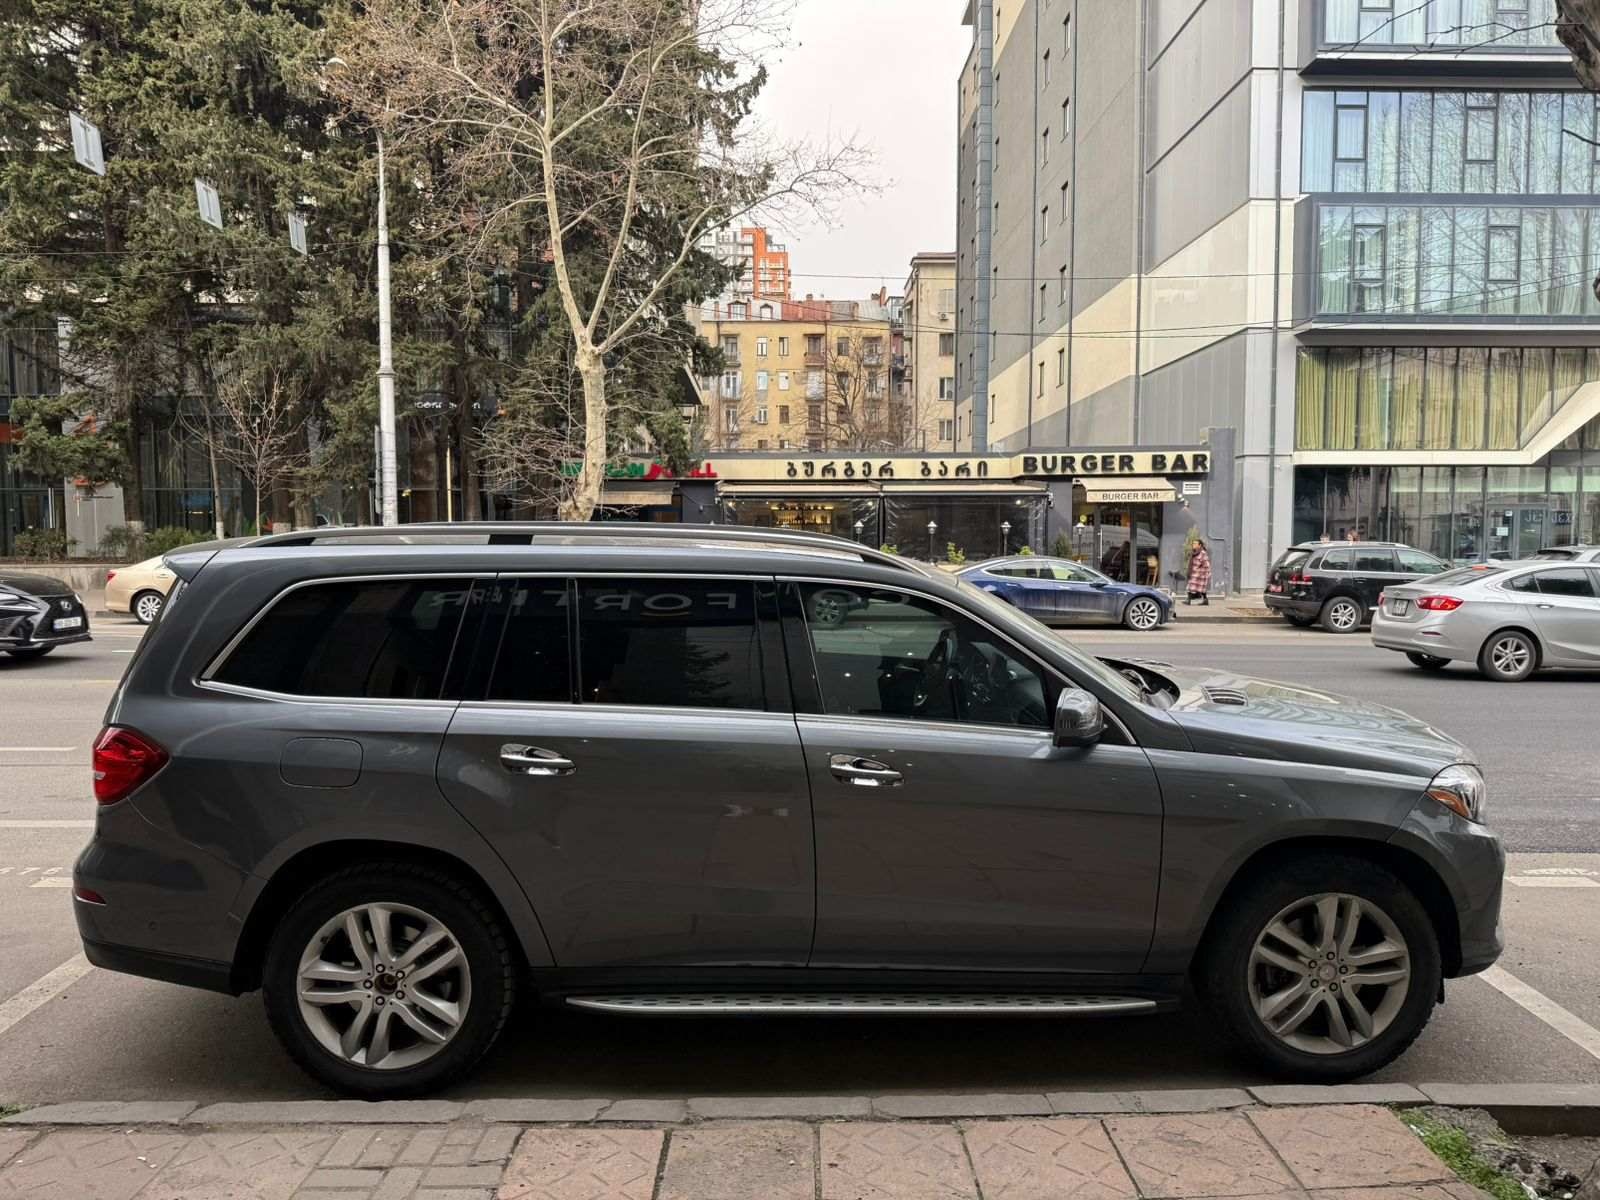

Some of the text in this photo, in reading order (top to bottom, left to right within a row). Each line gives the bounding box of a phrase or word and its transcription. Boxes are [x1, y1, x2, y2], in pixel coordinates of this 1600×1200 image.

[787, 460, 988, 477] ბურგერ ბარი
[1022, 453, 1209, 473] BURGER BAR
[1102, 492, 1159, 501] BURGER BAR
